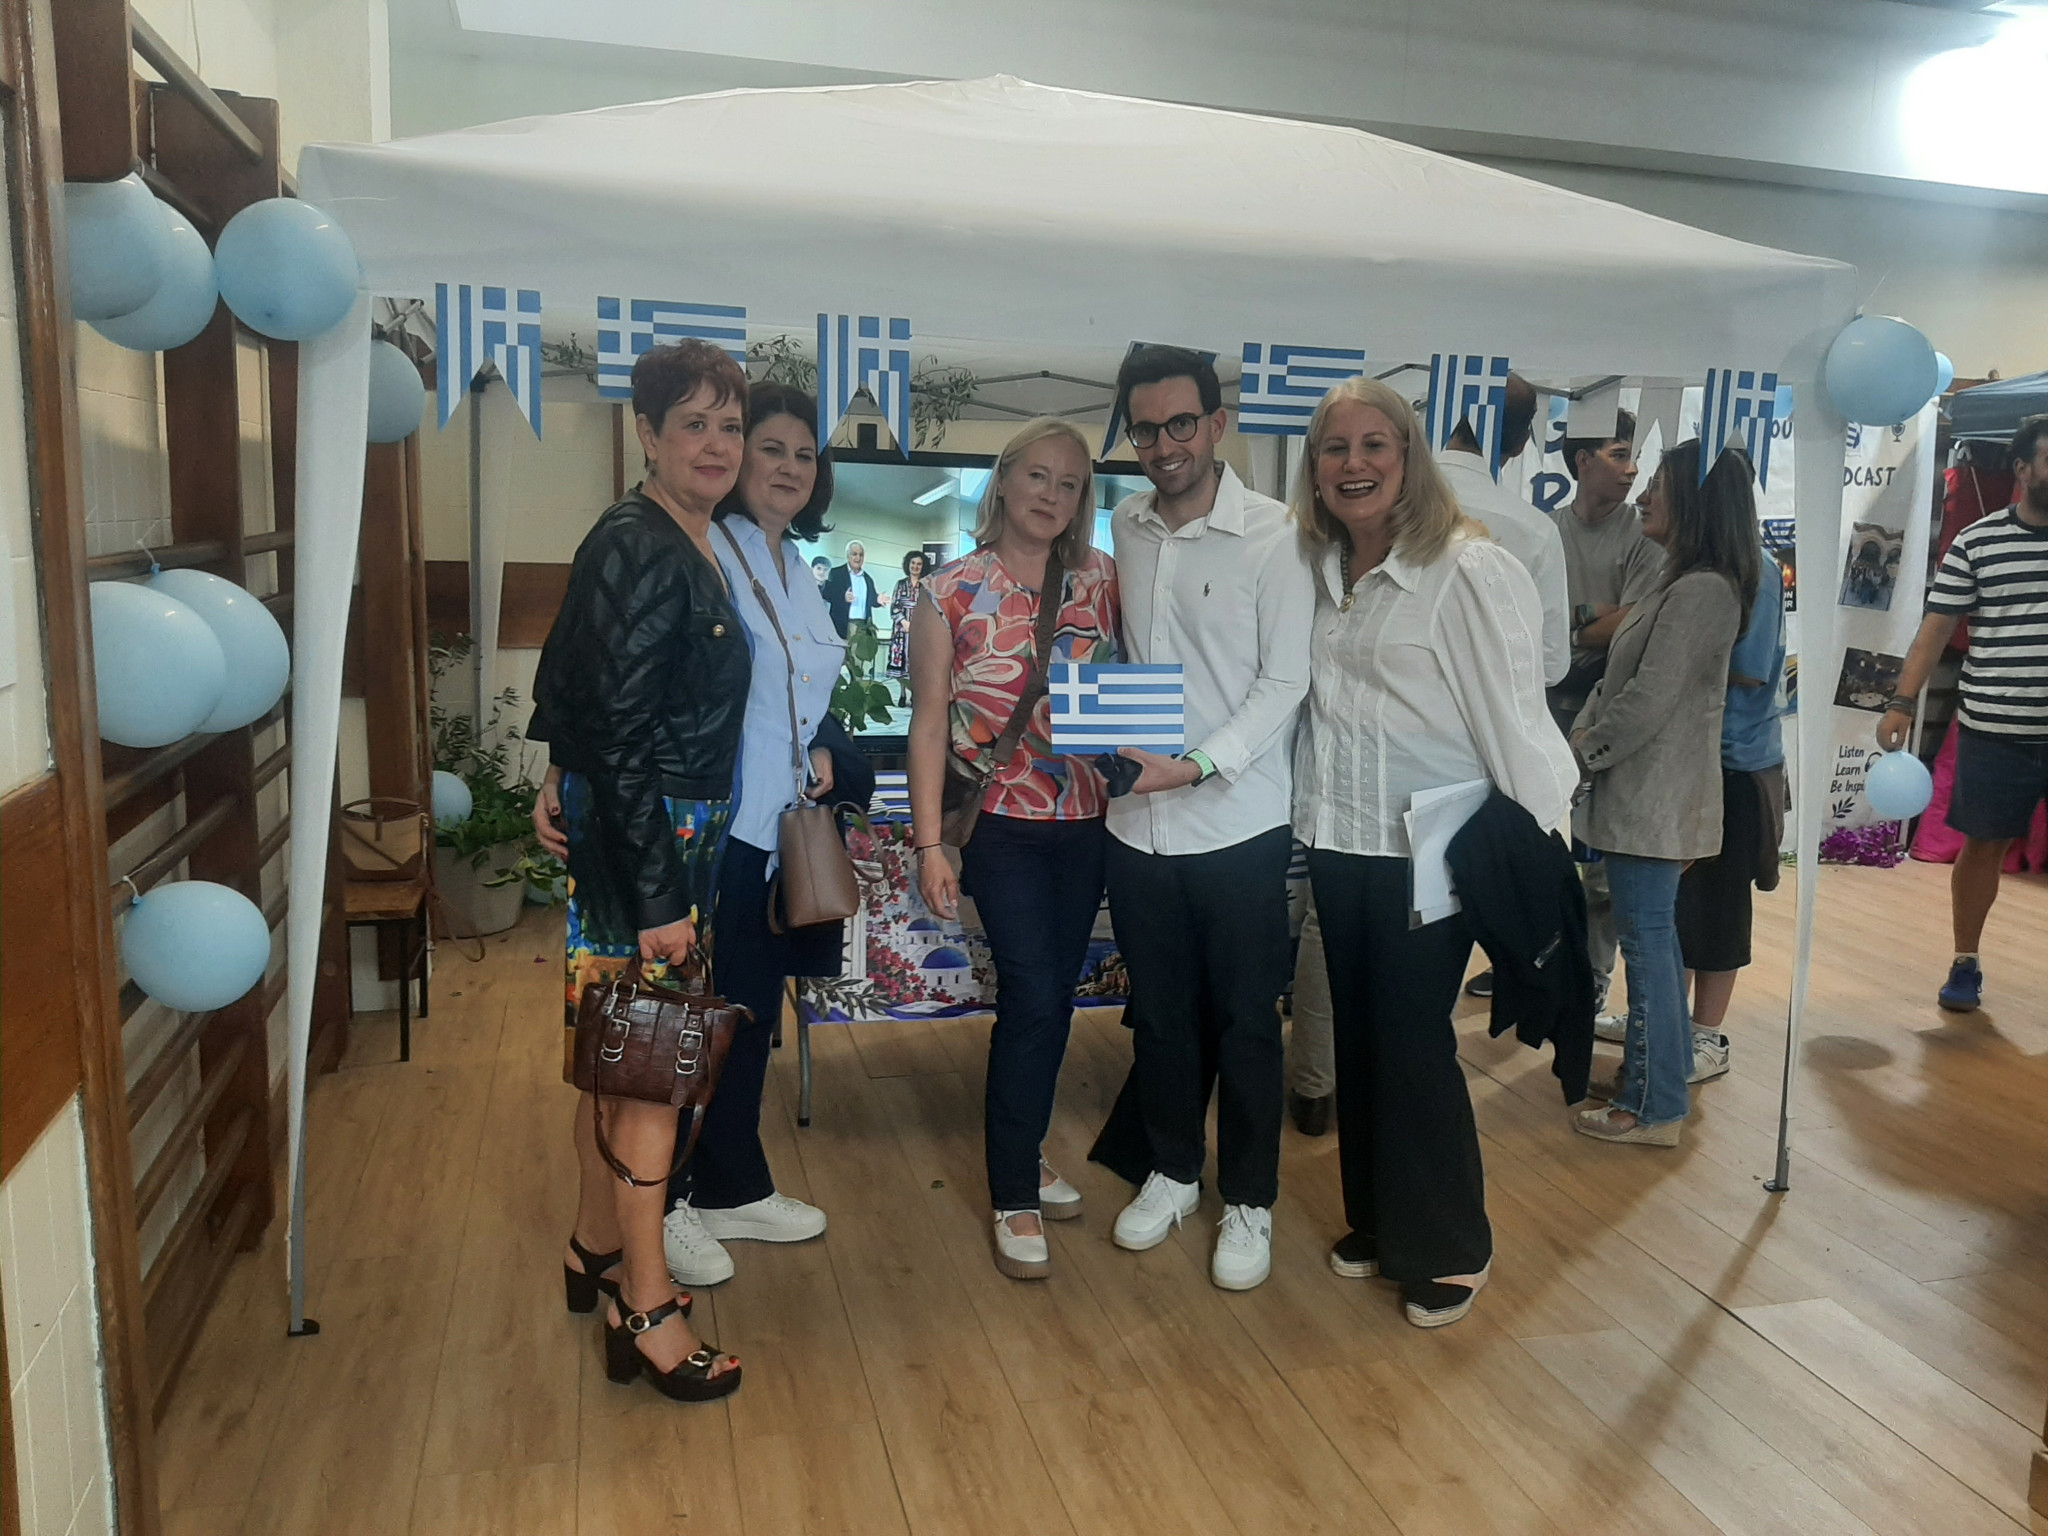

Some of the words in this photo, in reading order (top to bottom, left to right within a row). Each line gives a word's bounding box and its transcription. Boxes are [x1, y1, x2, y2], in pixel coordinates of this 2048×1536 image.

[1839, 745, 1865, 758] Listen
[1835, 762, 1861, 776] Learn
[1830, 780, 1843, 793] Be
[1845, 779, 1866, 795] Inspi
